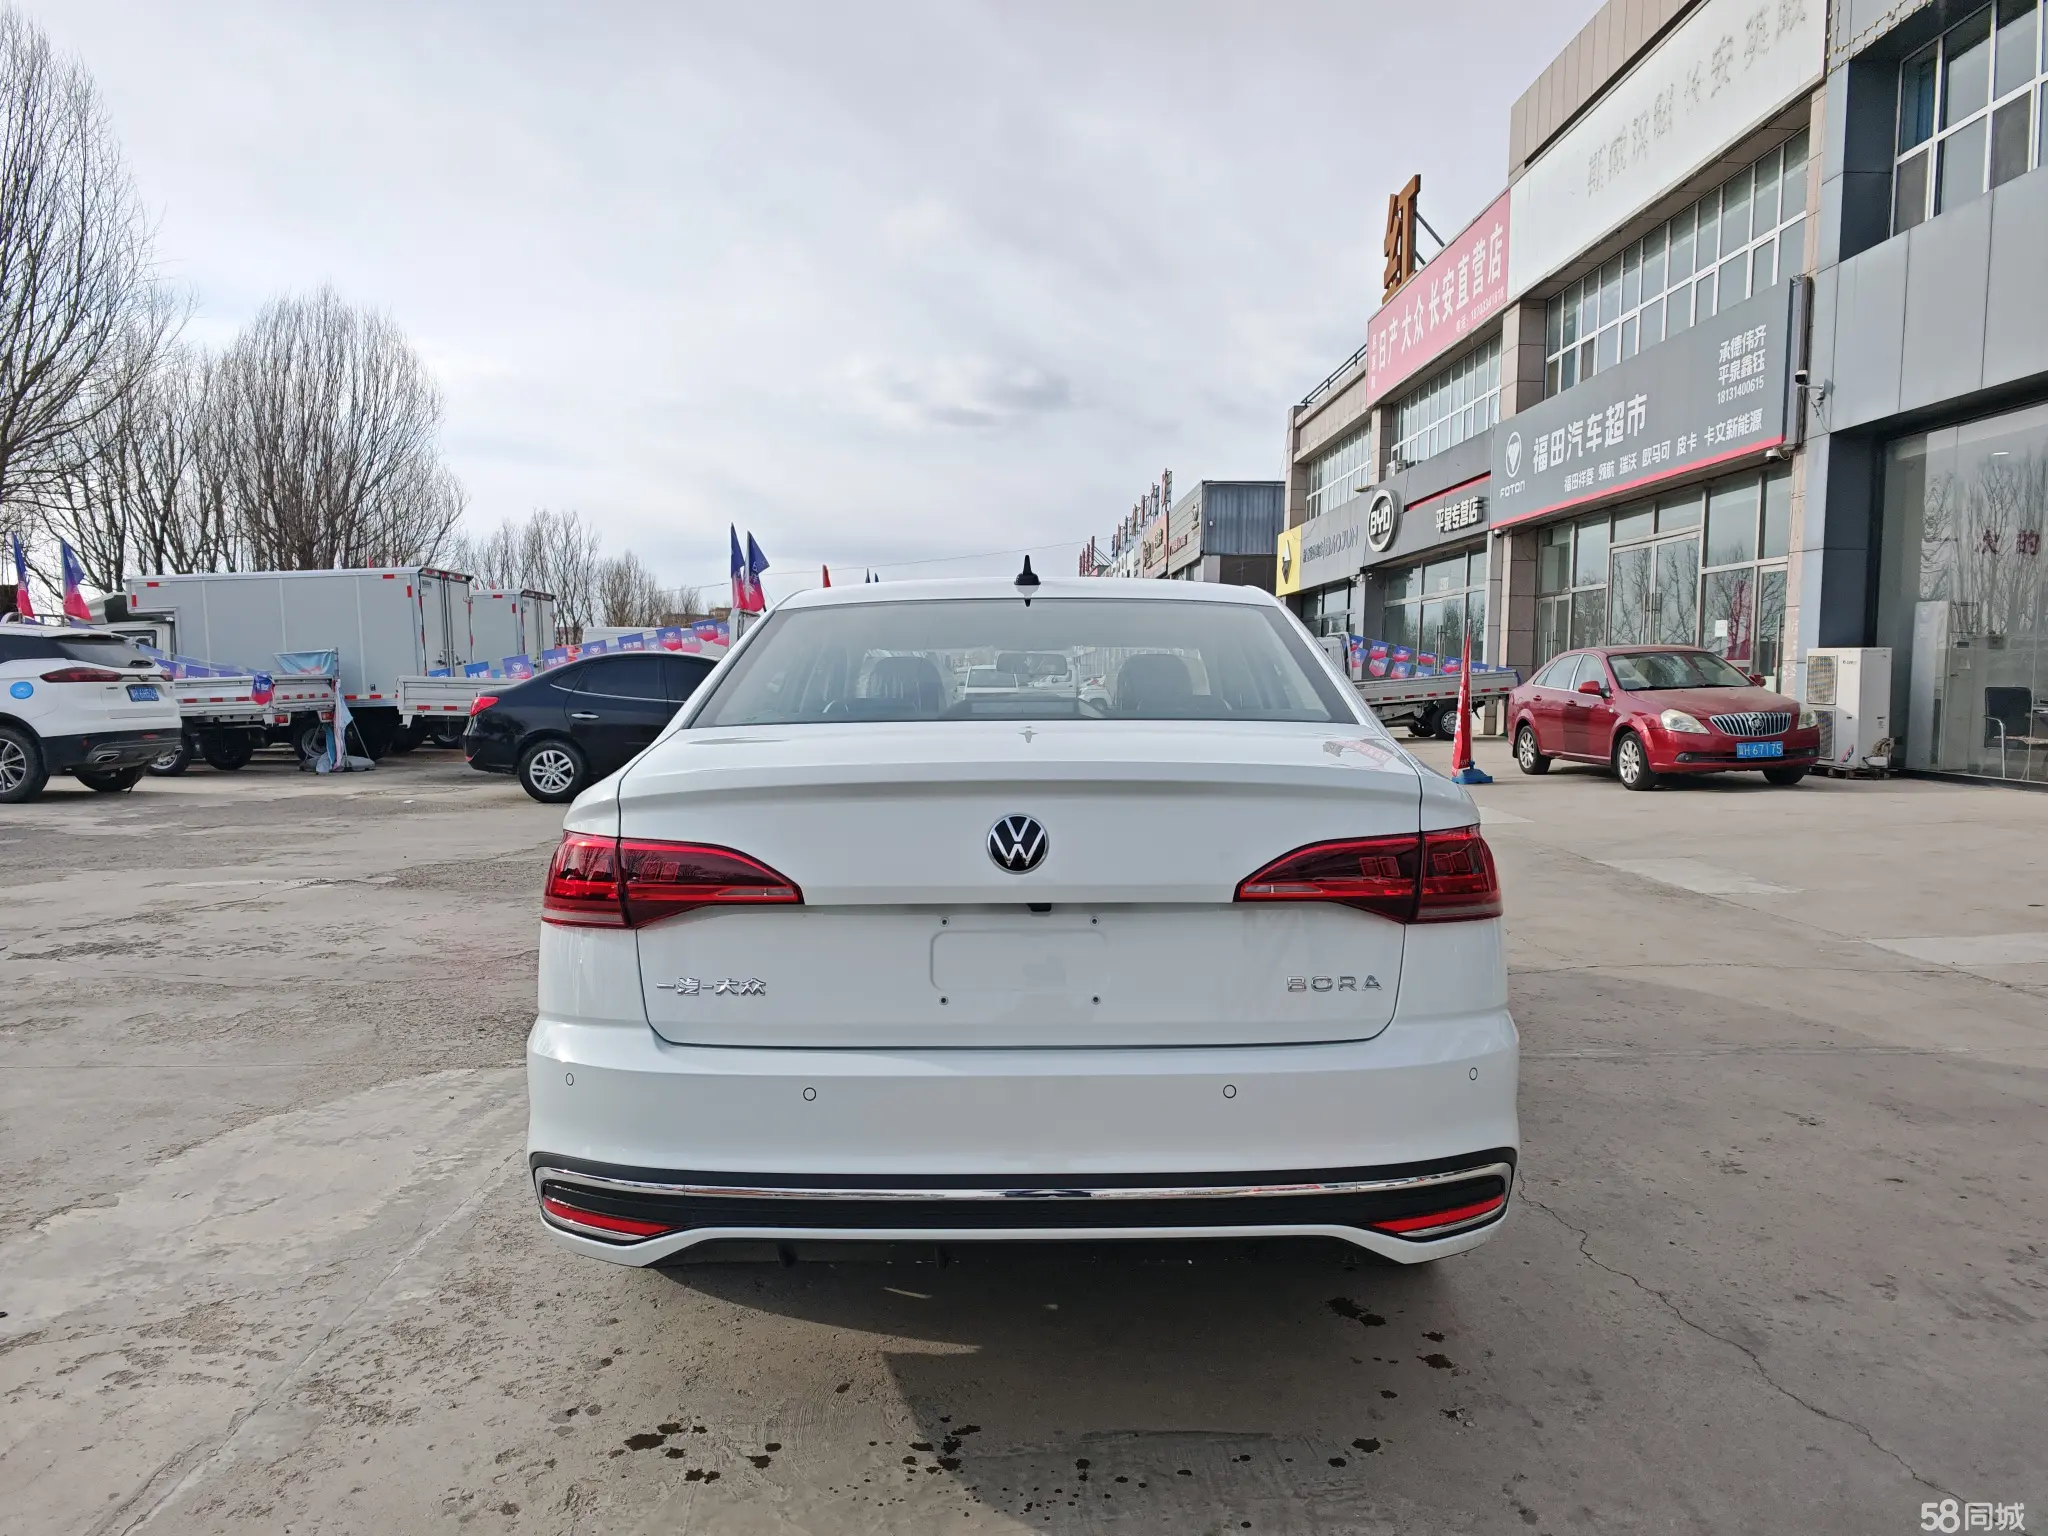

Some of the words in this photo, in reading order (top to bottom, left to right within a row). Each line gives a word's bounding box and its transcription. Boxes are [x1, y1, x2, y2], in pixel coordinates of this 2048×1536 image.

[1719, 324, 1767, 363] 承德伟齐
[1718, 349, 1766, 385] 平泉鑫钰
[1717, 375, 1765, 404] 18131400615
[1533, 393, 1648, 474] 福田汽车超市
[1642, 440, 1671, 468] 欧马可
[1676, 431, 1698, 457] 皮卡
[1704, 408, 1763, 446] 卡文新能源
[1370, 505, 1391, 537] BYD
[1436, 496, 1482, 534] 平泉专营店
[656, 977, 766, 996] 一汽-大众
[1286, 974, 1382, 992] BORA
